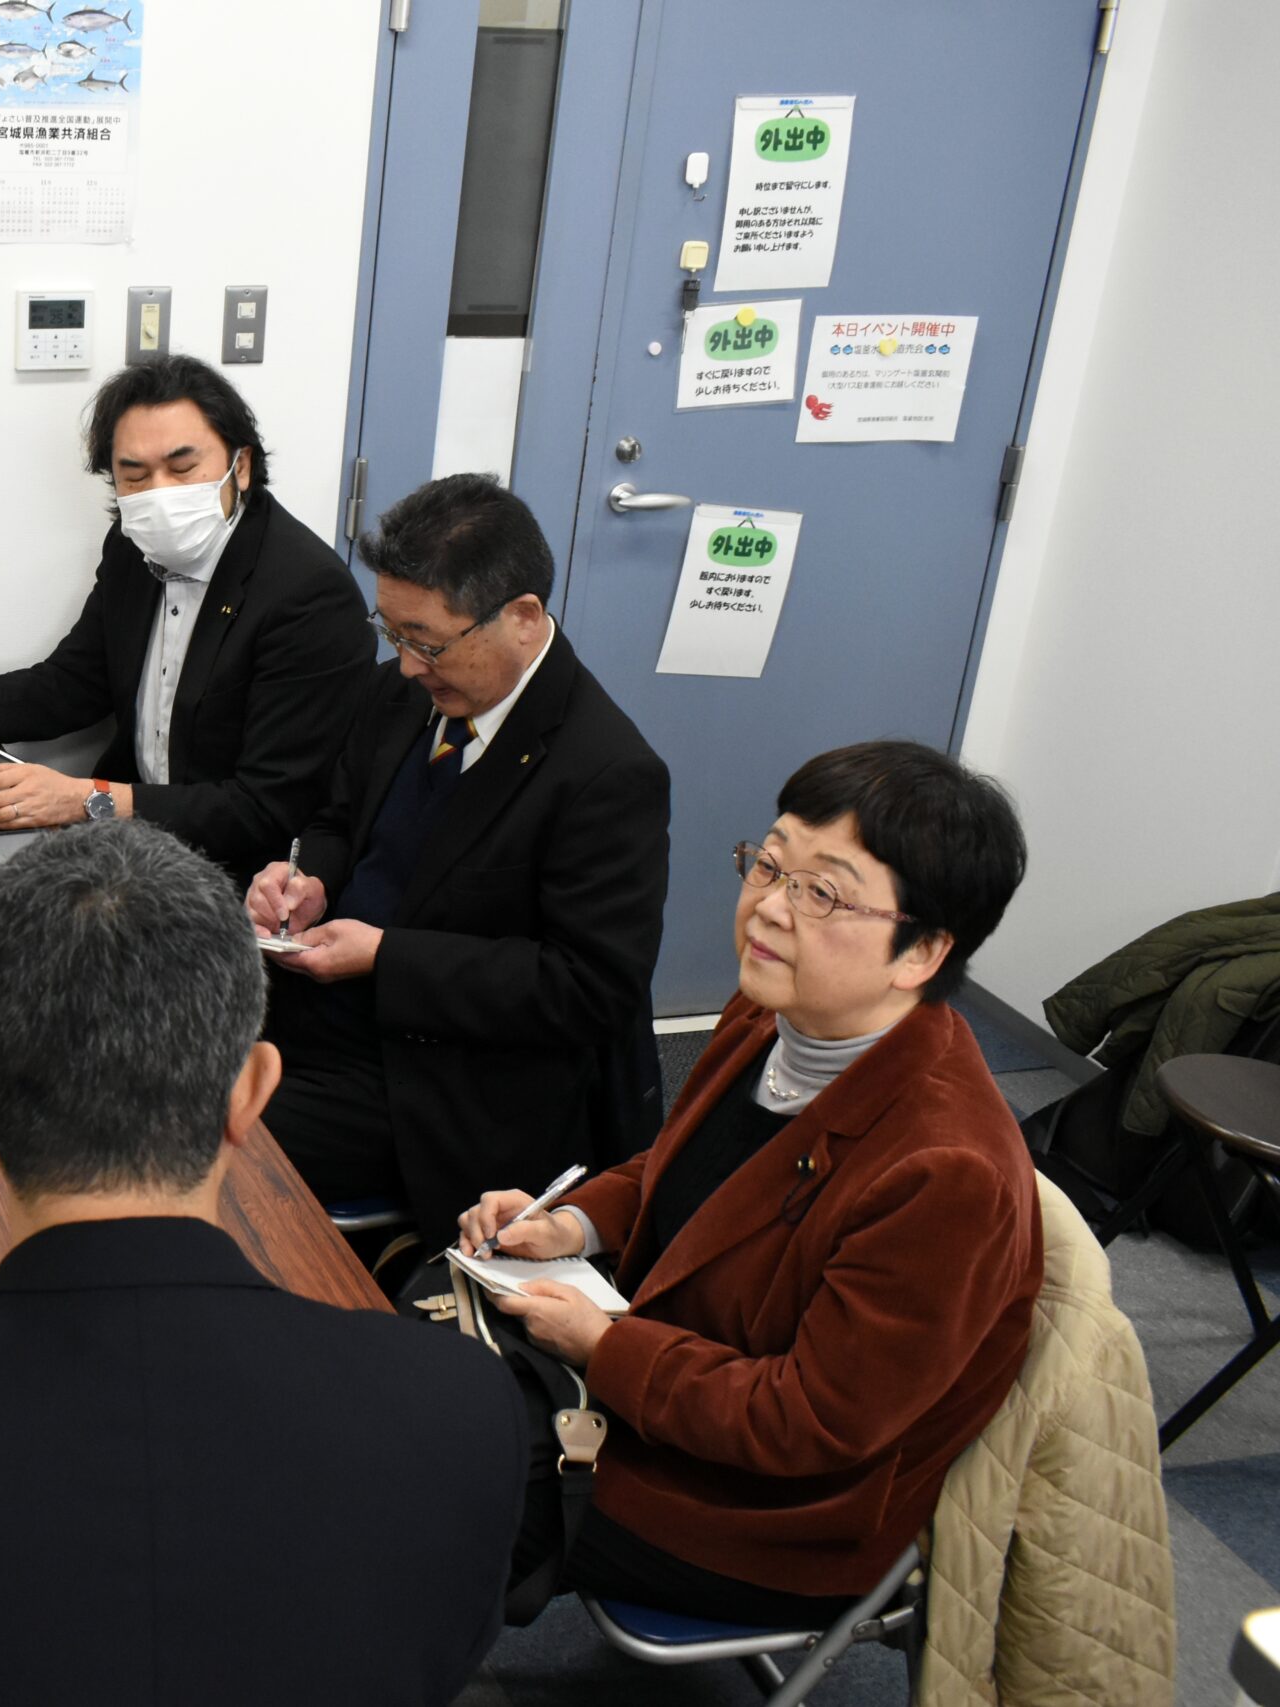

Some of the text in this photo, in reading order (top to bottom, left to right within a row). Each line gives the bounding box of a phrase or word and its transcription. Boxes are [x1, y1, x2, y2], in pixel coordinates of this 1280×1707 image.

[760, 125, 825, 152] 外出中
[831, 322, 957, 337] 本日イベント開催中
[709, 324, 774, 352] 外出中
[854, 344, 924, 355] 塩釜水直売会
[696, 366, 772, 381] すぐに戻りますので
[695, 381, 780, 397] 少しお待ちください。
[713, 534, 773, 559] 外出中
[706, 586, 754, 598] すぐ戻ります。
[689, 599, 763, 613] 少しお待ちください。
